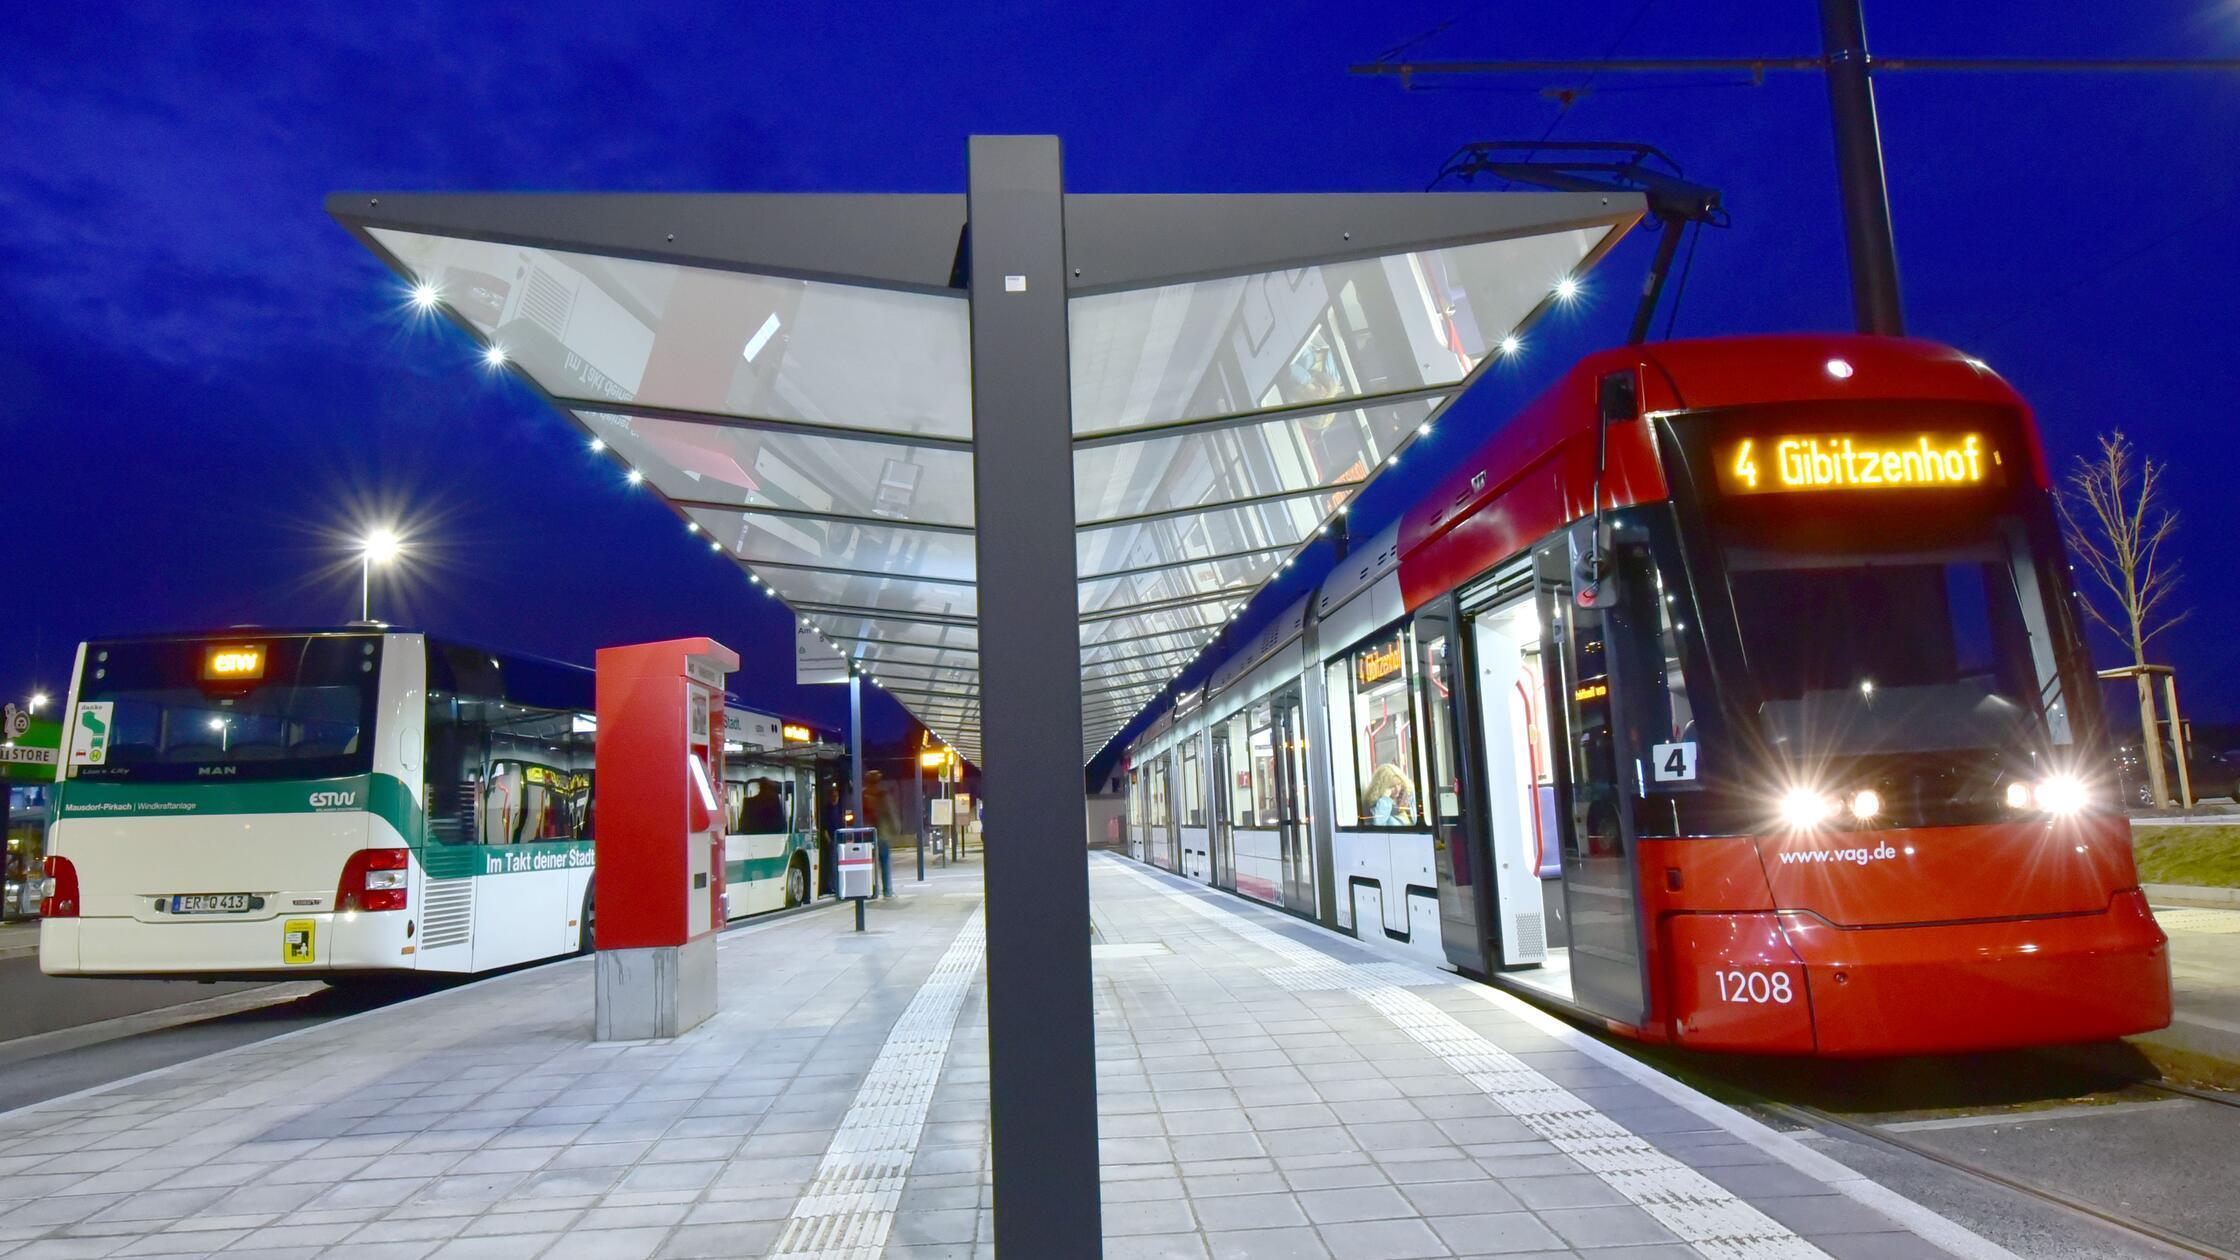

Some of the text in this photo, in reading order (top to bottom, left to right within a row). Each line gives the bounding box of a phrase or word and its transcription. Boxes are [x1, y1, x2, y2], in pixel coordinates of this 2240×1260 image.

[1734, 435, 1979, 488] 4 Gibitzenhof
[12, 748, 50, 761] STORE
[1664, 748, 1687, 777] 4
[198, 765, 237, 776] MAN
[138, 802, 197, 811] Windkraftanlage
[309, 791, 356, 807] ESTW
[486, 847, 595, 874] Im Takt deiner Stadt
[1779, 840, 1896, 865] www.vag.de
[184, 895, 244, 910] ER Q 413
[1715, 970, 1793, 1004] 1208
